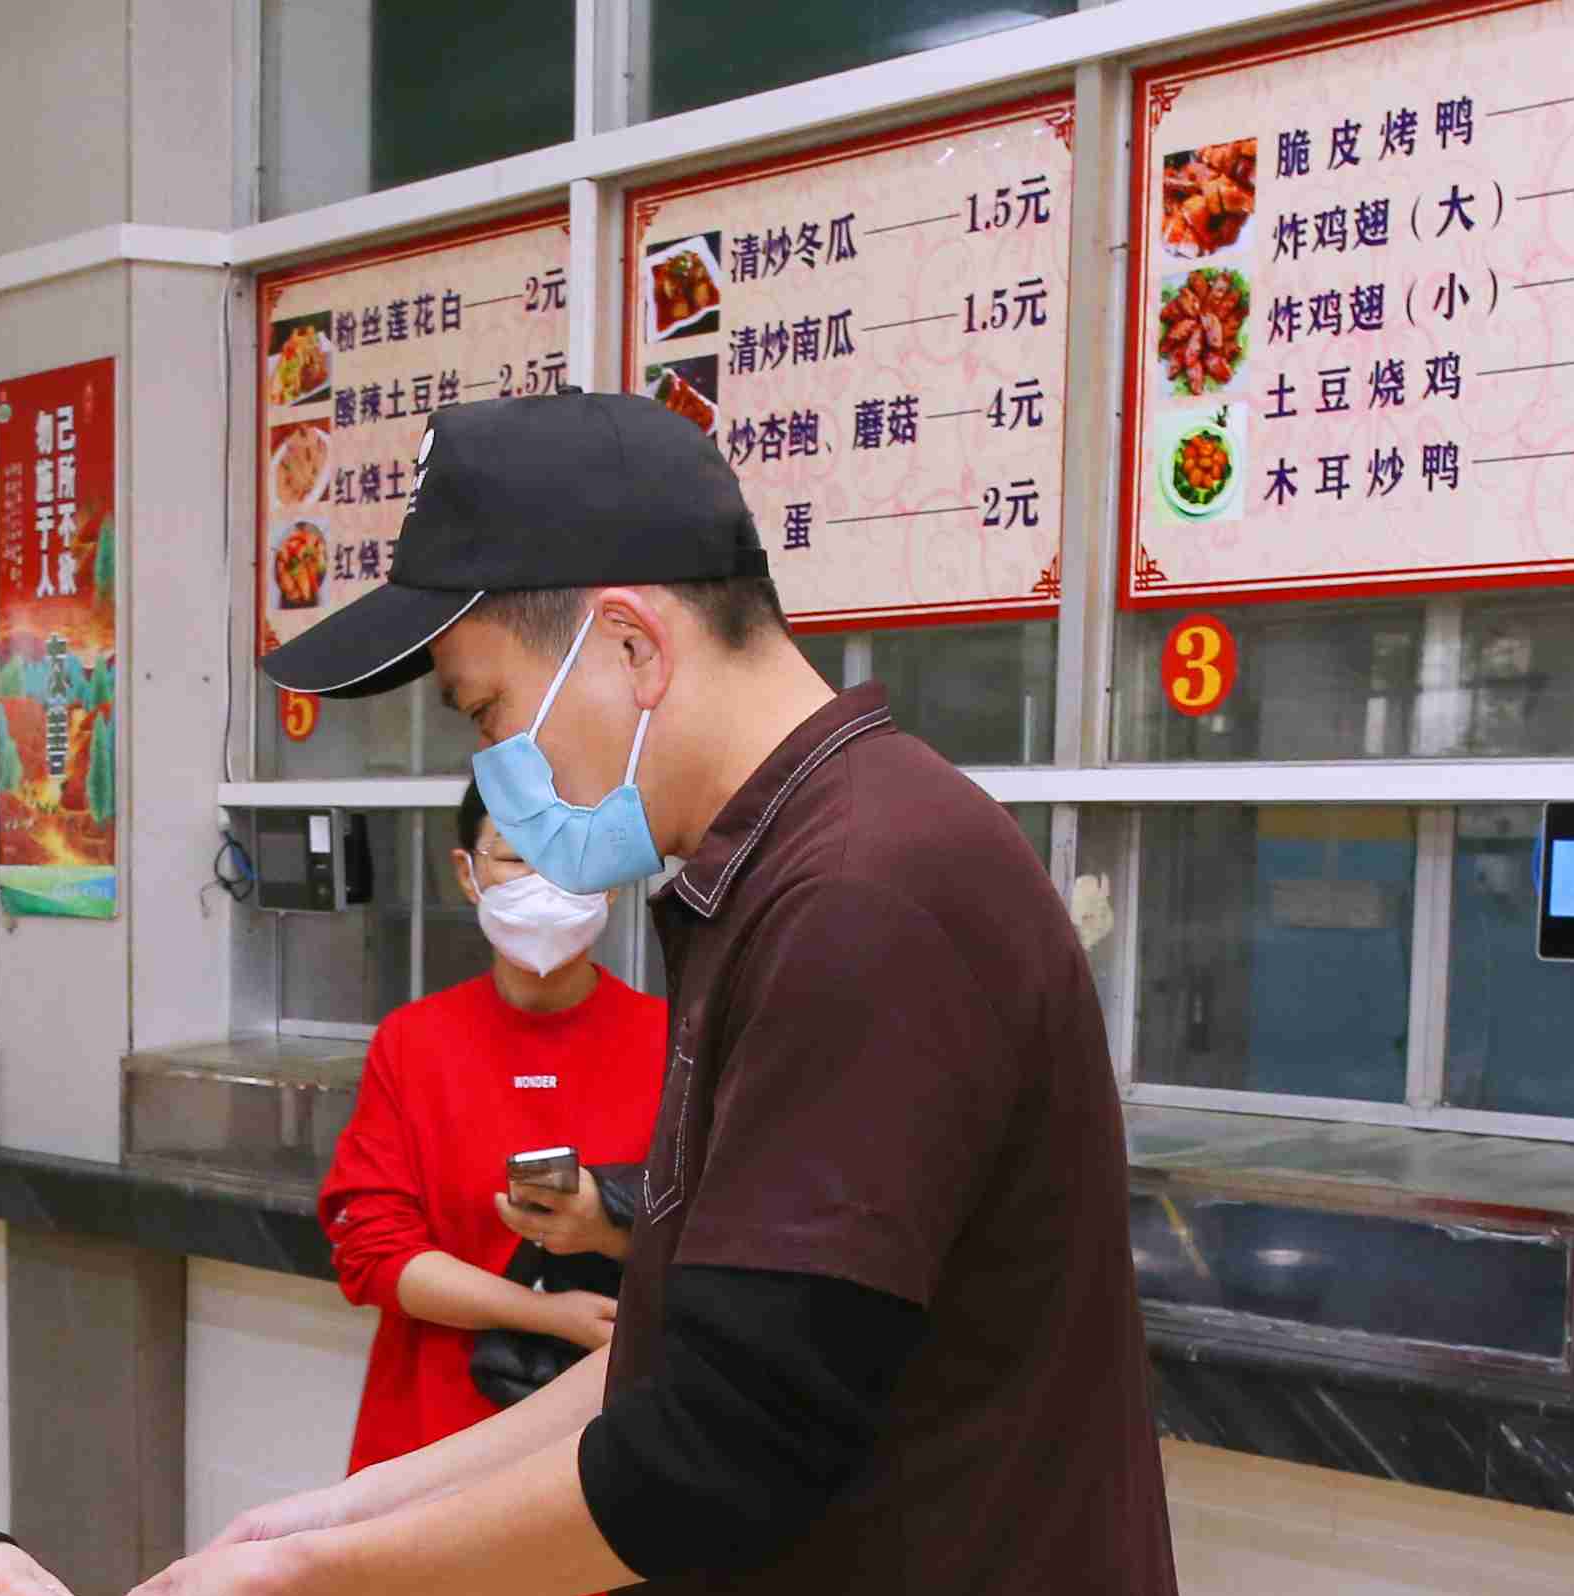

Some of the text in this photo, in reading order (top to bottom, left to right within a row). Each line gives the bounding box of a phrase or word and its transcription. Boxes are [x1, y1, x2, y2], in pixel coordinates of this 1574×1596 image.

[1274, 96, 1474, 181] 脆皮烤鸭
[730, 174, 1051, 283] 清炒冬瓜 1.5元
[335, 268, 567, 353] 粉丝莲花白 2元
[728, 277, 1048, 376] 清炒南瓜 1.5元
[334, 351, 567, 430] 酸辣土豆丝 2.5元
[986, 378, 1044, 430] 4元
[1263, 350, 1463, 423] 土豆烧鸡
[982, 478, 1040, 531] 2元
[1262, 440, 1461, 507] 木耳炒鸭
[1172, 625, 1222, 708] 3
[287, 692, 314, 736] 5
